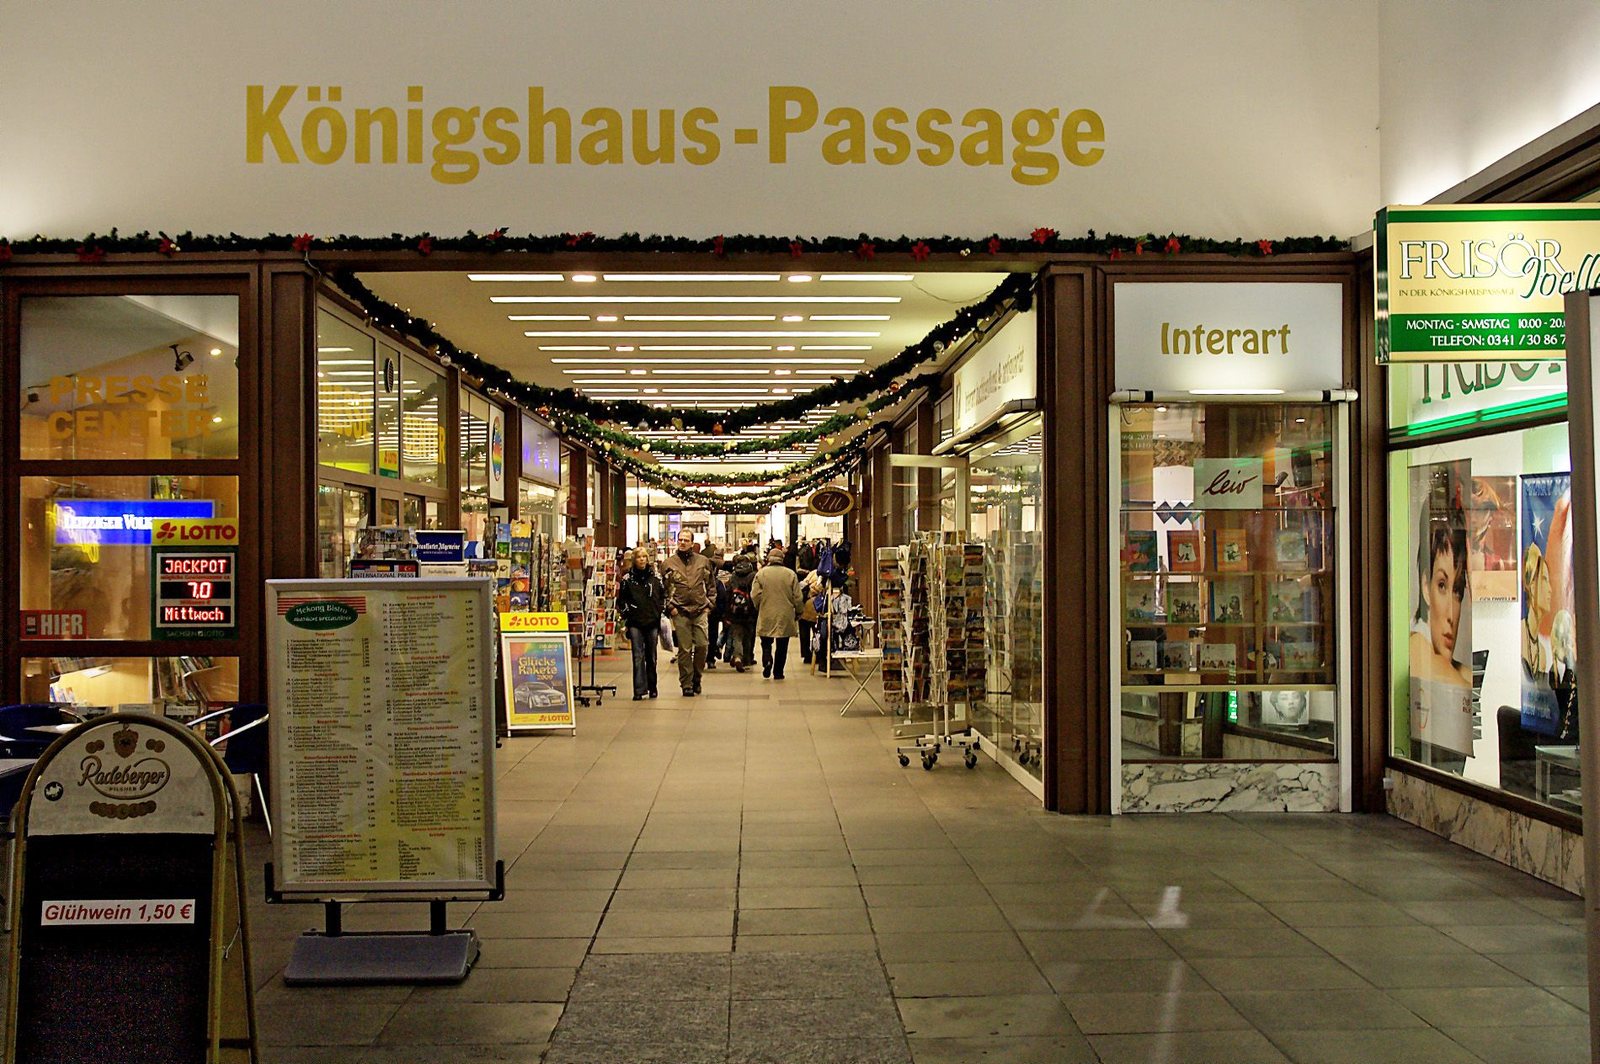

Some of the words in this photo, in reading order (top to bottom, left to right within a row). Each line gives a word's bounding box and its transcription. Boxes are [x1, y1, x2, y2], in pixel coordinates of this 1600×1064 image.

[246, 85, 1105, 186] Königshaus-Passage
[1399, 232, 1574, 279] FRISÖR
[1520, 253, 1600, 298] Joell
[1398, 289, 1408, 297] IN
[1410, 289, 1428, 297] DER
[1406, 319, 1454, 330] MONTAG
[1461, 318, 1510, 329] SAMSTAG
[1518, 318, 1542, 329] 10.00
[1549, 318, 1566, 329] 20.
[1161, 322, 1291, 355] Interart
[1430, 335, 1485, 347] TELEFON:
[1487, 334, 1514, 346] 0341
[1527, 334, 1541, 345] 30
[1543, 334, 1557, 345] 86
[50, 375, 209, 404] PRESSE
[49, 410, 213, 440] CENTER
[180, 525, 237, 540] LOTTO
[165, 559, 227, 574] JACKPOT
[187, 581, 212, 599] 7,0
[164, 607, 224, 622] Mittwoch
[524, 616, 560, 627] LOTTO
[41, 613, 83, 636] HIER
[518, 656, 557, 667] Glücks
[518, 664, 559, 676] Rakete
[78, 755, 170, 792] Radeberger
[45, 904, 132, 920] Glühwein
[138, 904, 175, 922] 1,50
[179, 903, 193, 920] €
